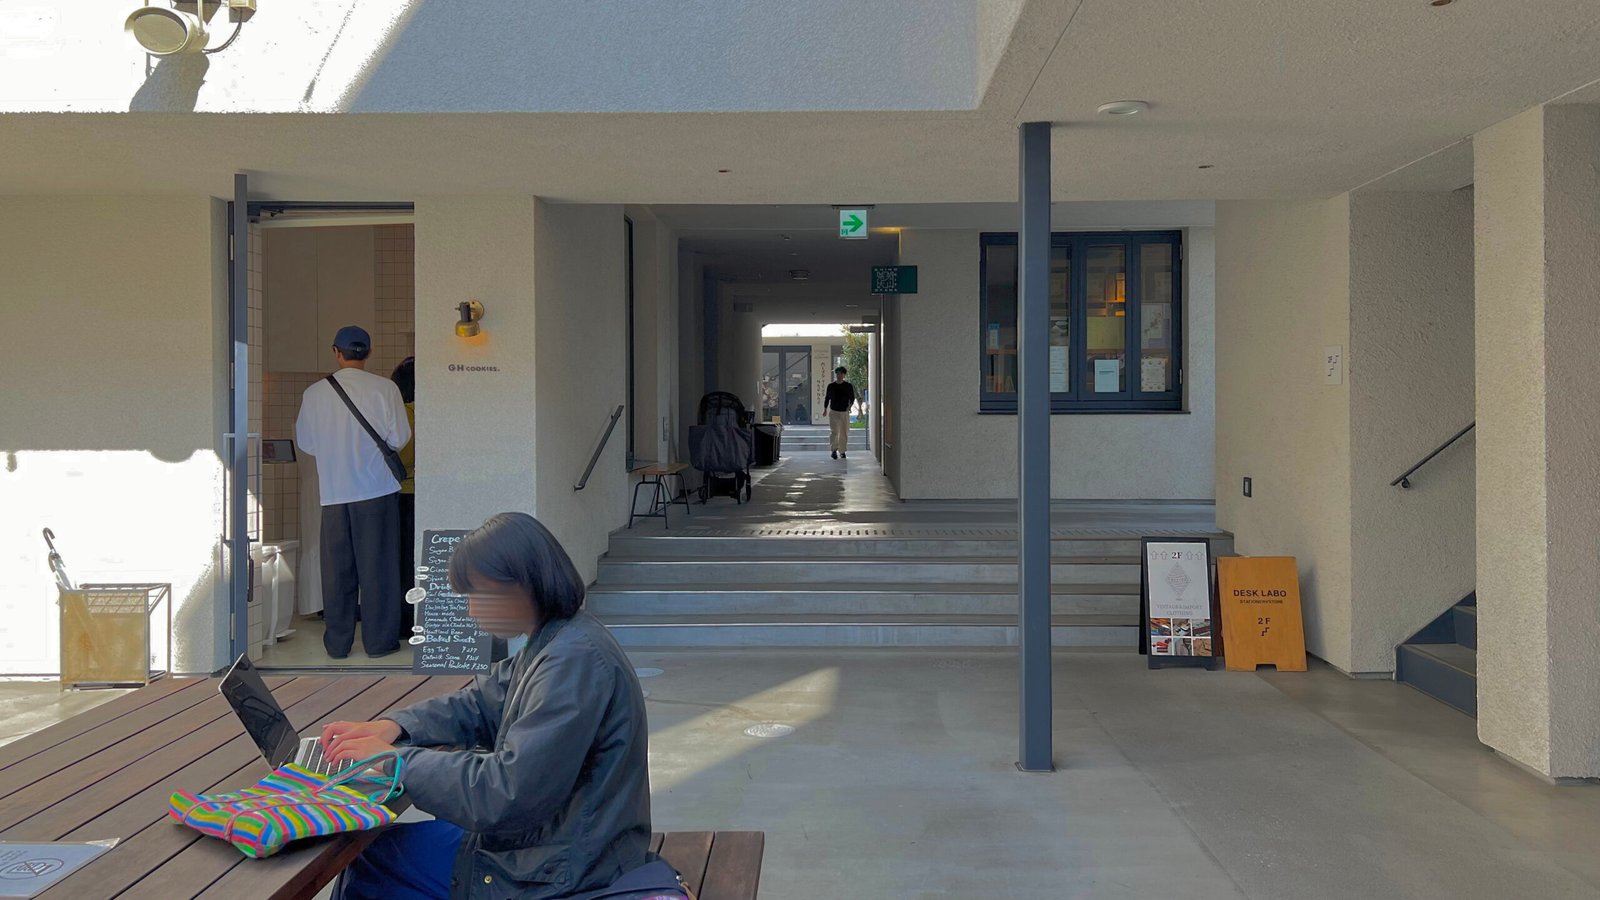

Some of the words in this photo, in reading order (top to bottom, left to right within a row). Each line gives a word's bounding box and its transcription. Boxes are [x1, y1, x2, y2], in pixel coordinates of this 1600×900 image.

[431, 534, 461, 545] Crepe
[429, 546, 447, 555] Sugar
[1171, 551, 1183, 560] 2F
[1233, 589, 1259, 597] DESK
[1261, 589, 1287, 598] LABO
[425, 634, 451, 643] Baked
